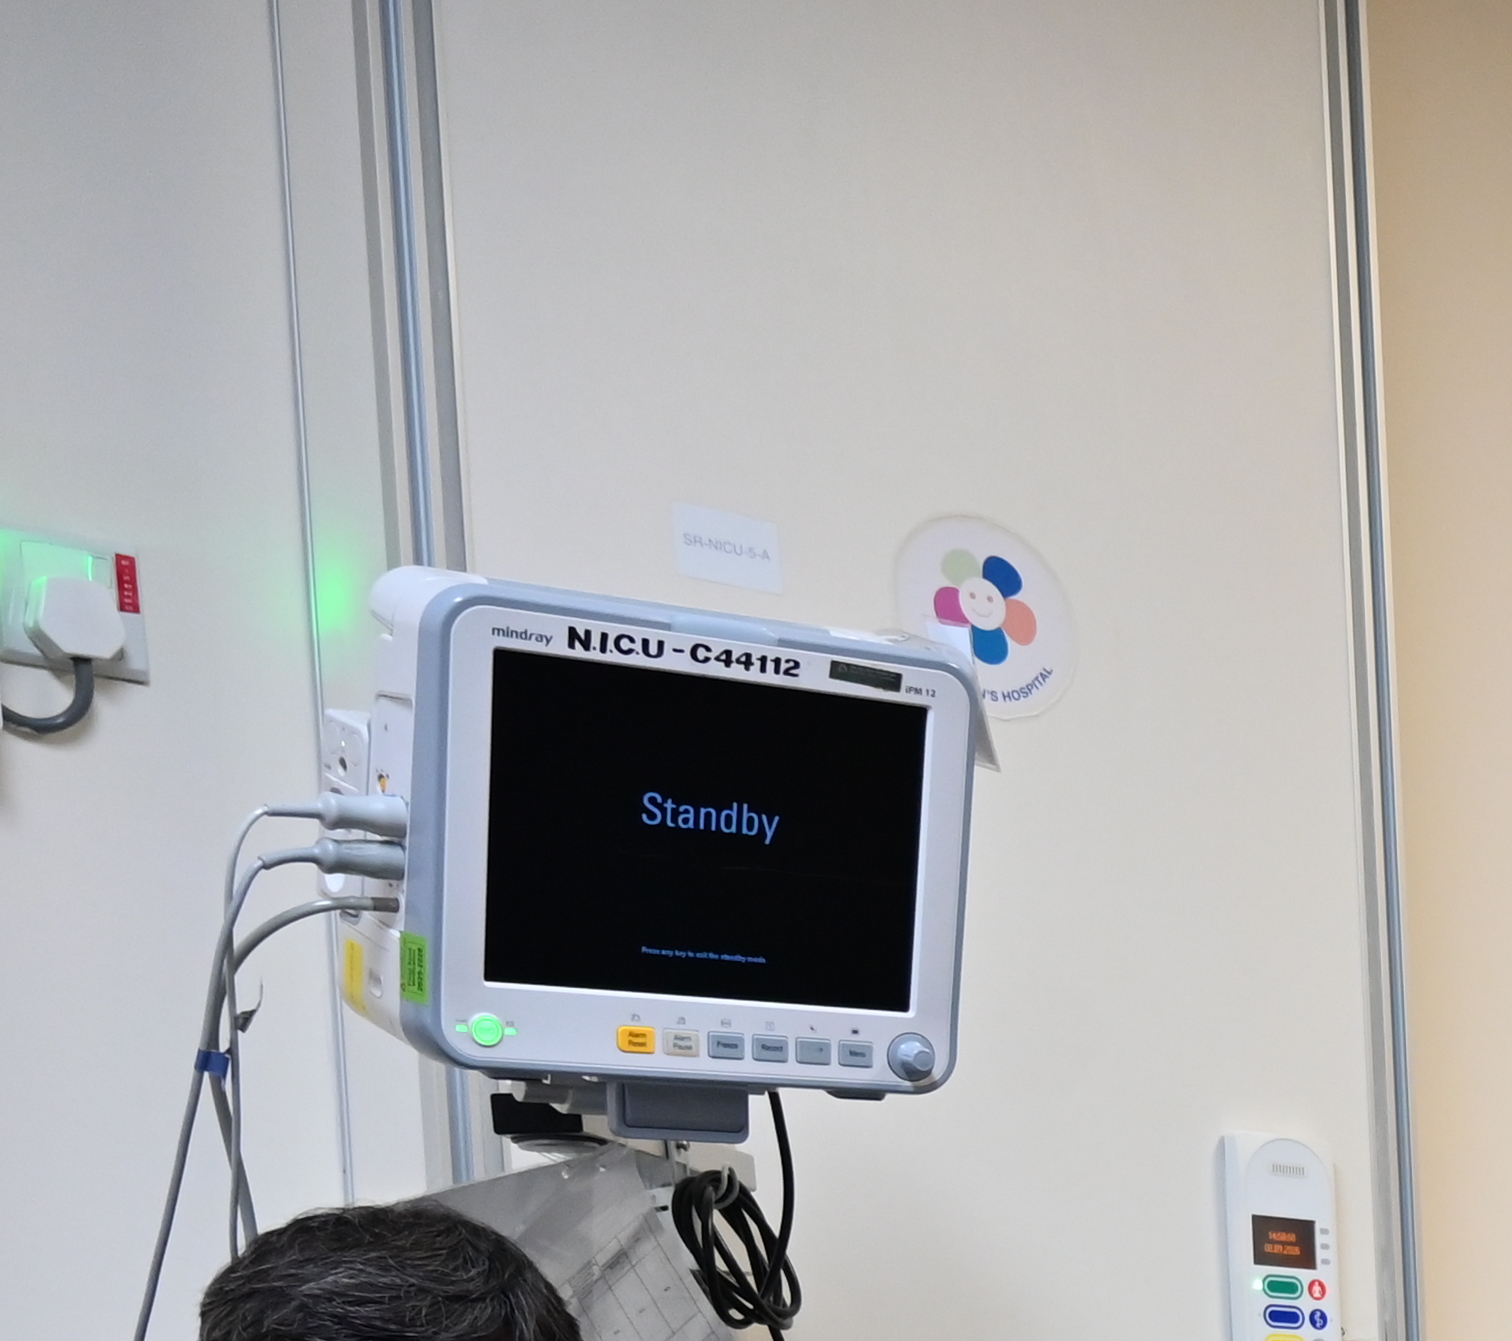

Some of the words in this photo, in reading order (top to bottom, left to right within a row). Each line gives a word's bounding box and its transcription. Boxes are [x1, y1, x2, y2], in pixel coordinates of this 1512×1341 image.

[682, 532, 772, 563] SR-NICU-5-A
[491, 625, 554, 647] mindray
[690, 642, 801, 677] C44112
[1001, 666, 1054, 702] HOSPITAL
[641, 792, 780, 845] Standby
